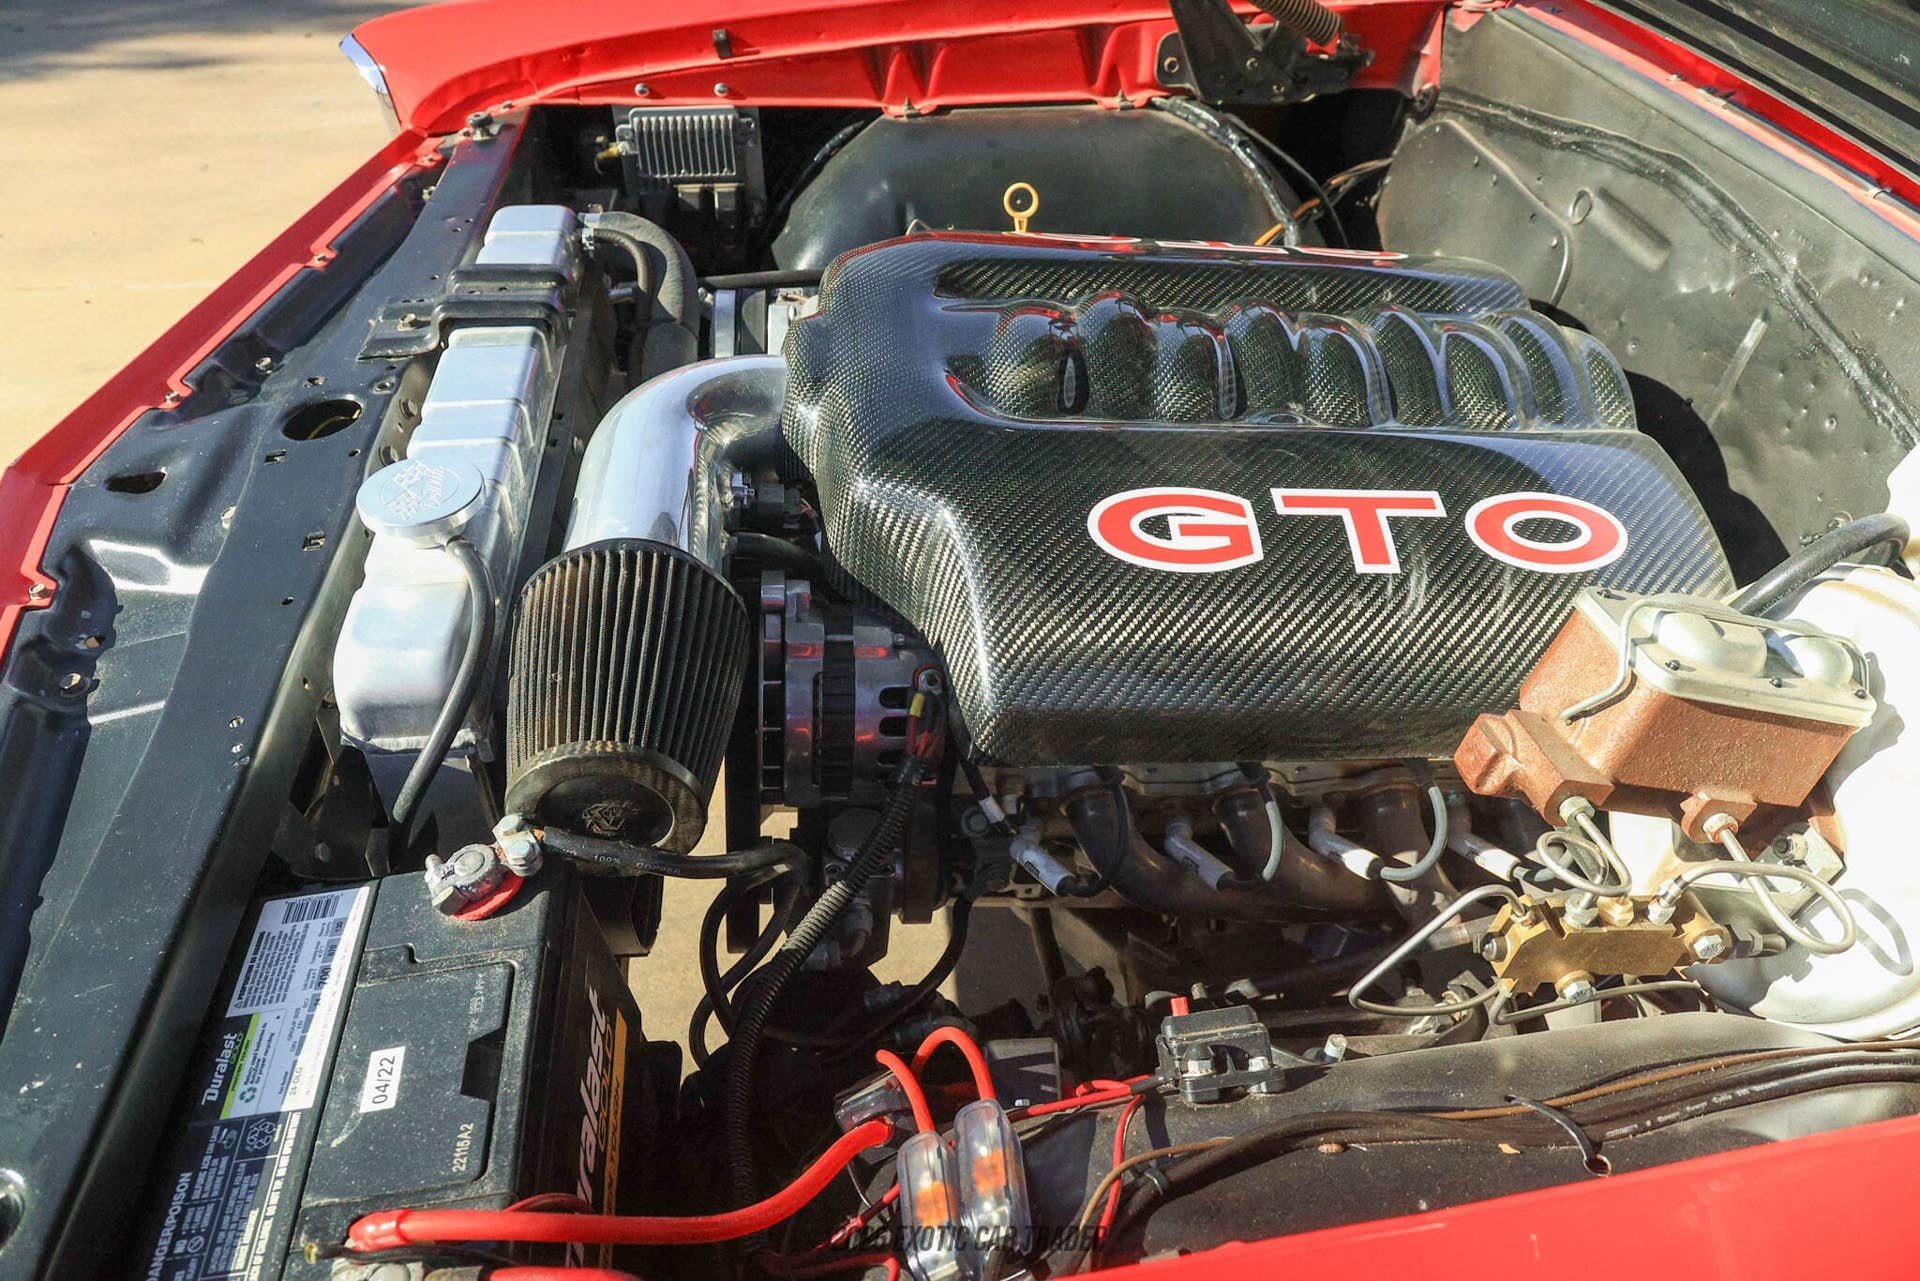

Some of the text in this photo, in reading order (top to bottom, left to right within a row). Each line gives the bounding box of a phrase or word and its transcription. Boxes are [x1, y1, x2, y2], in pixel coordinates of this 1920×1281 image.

[1087, 487, 1628, 573] GTO
[316, 967, 331, 987] 700
[201, 1032, 238, 1105] Duralast
[372, 1055, 395, 1103] 04/22
[599, 1019, 614, 1153] GOLD
